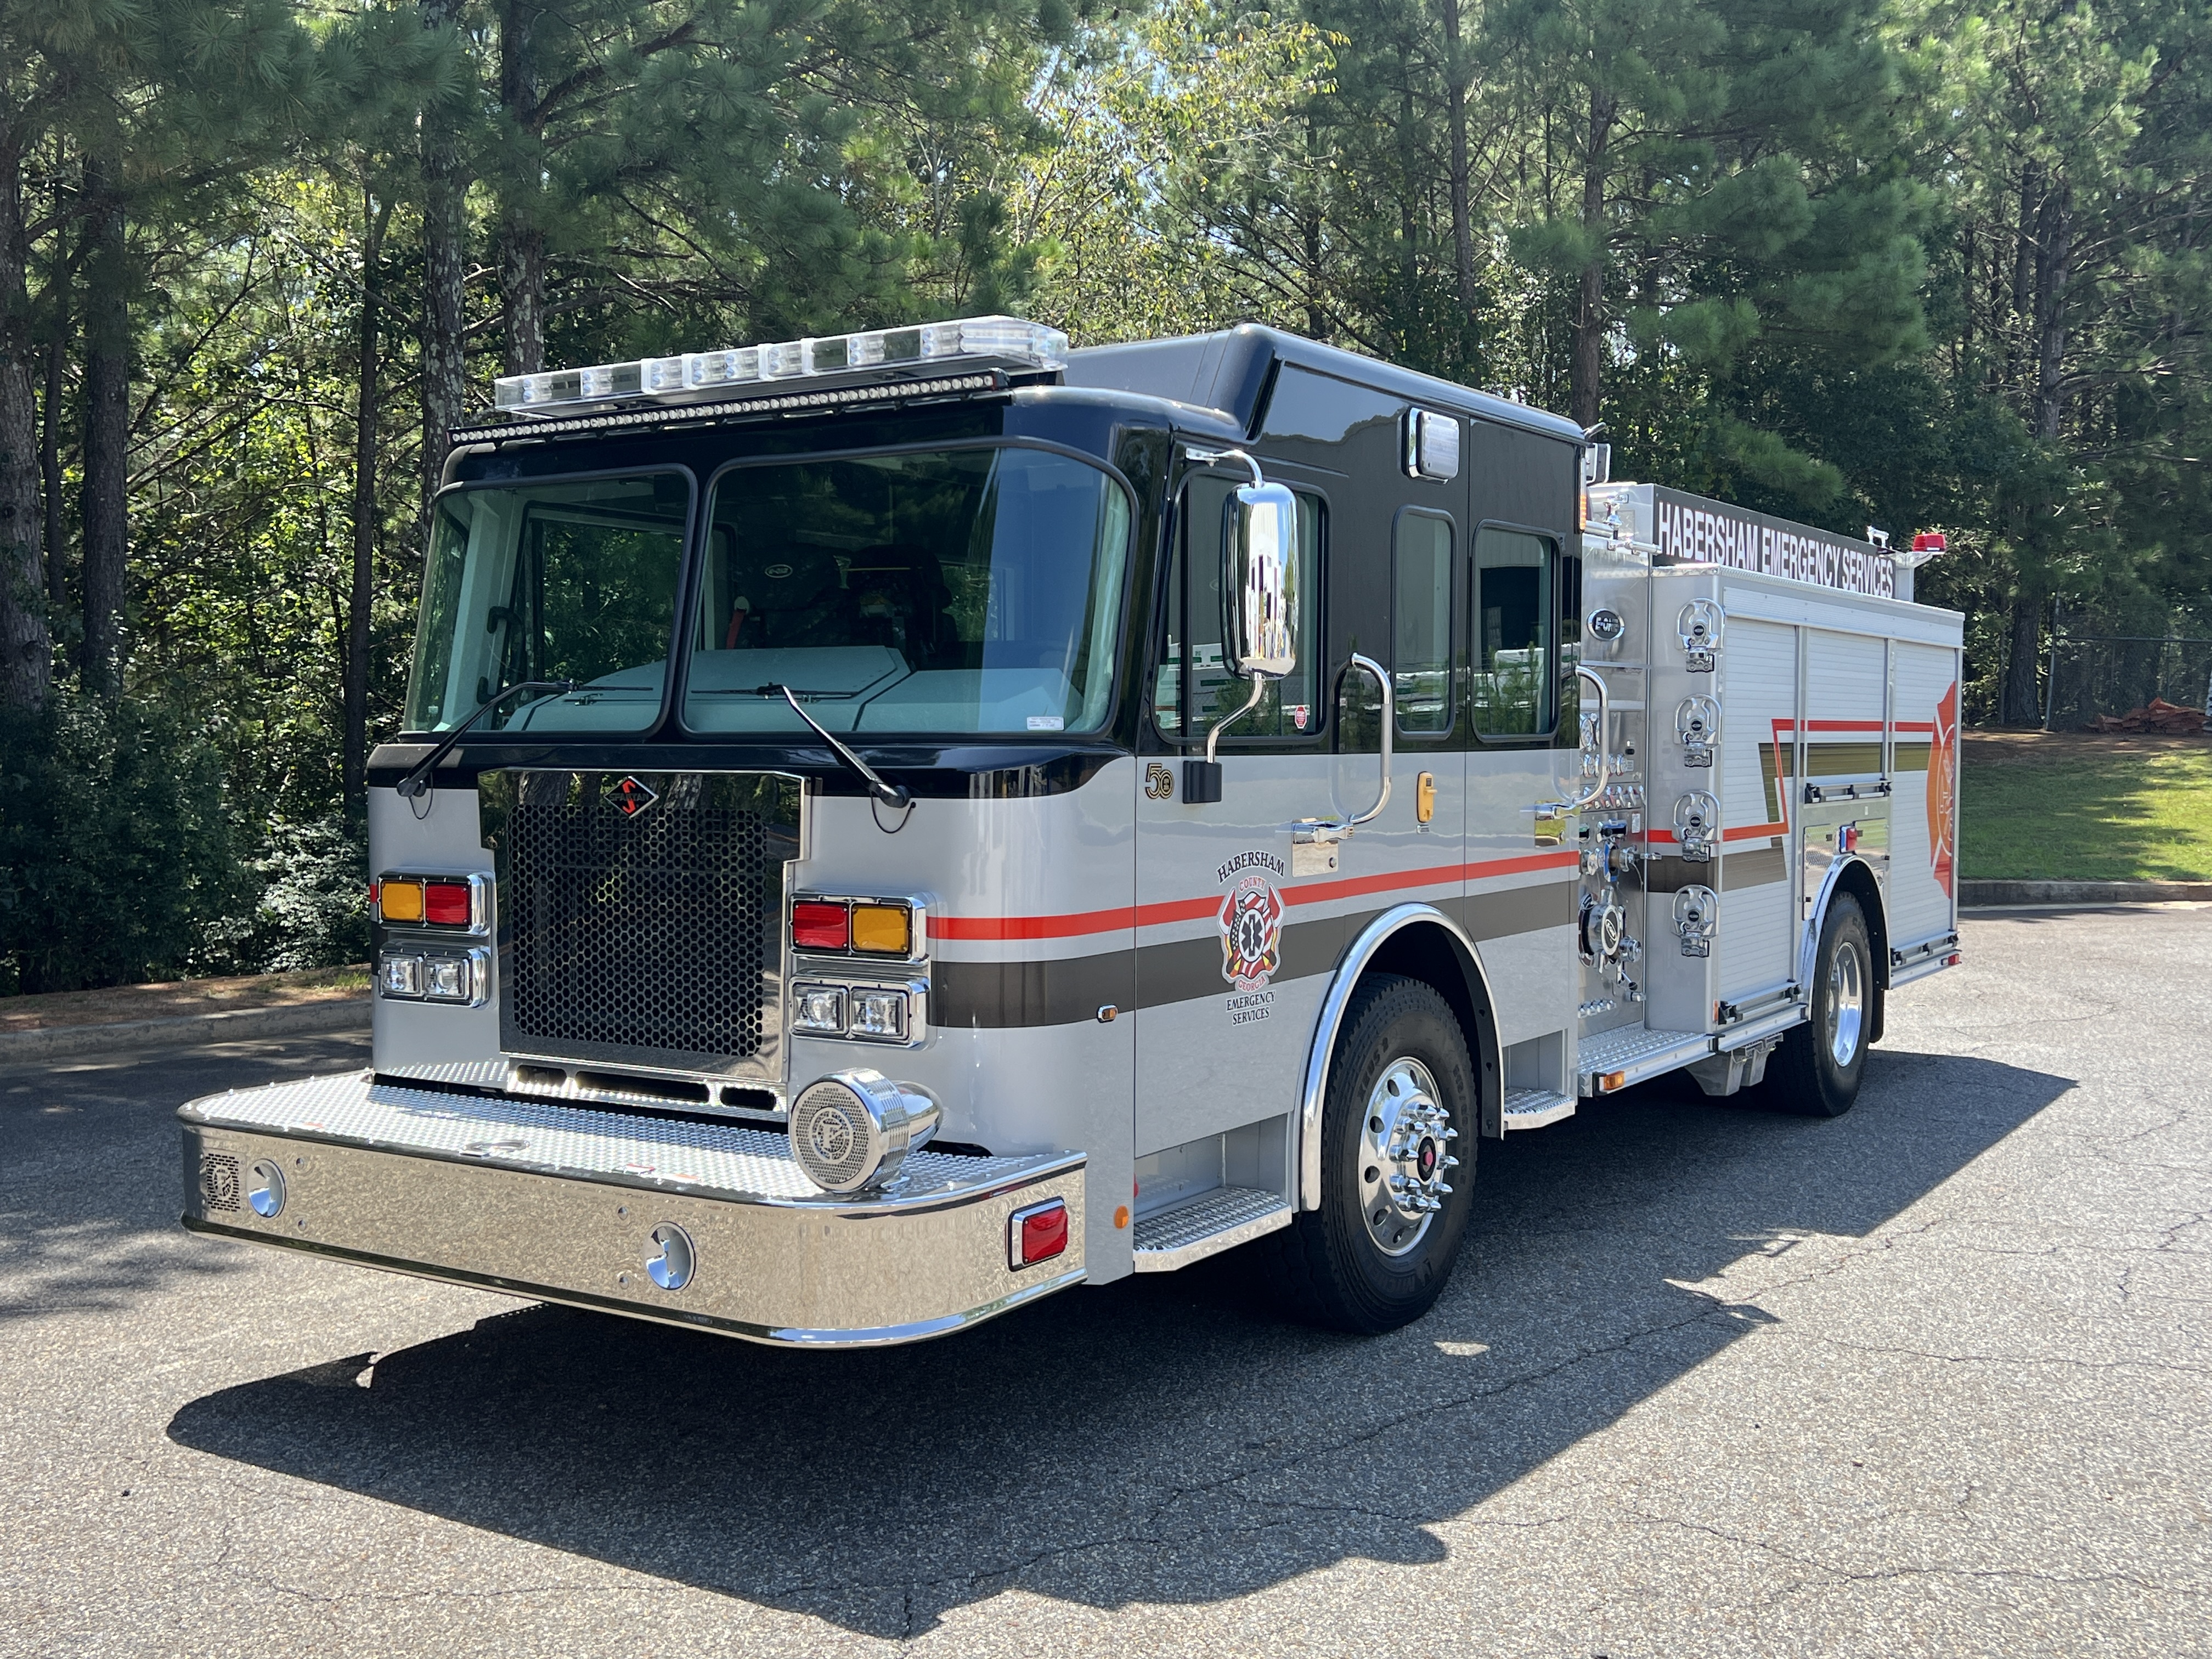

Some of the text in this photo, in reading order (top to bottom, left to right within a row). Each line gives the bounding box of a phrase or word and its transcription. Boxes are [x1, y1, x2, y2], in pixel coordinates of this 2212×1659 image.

[1658, 501, 1894, 598] HABERSHAM EMERGENCY SERVICES
[1145, 763, 1175, 799] 50
[609, 793, 649, 801] SPARTAN
[1217, 850, 1285, 883] HABERSHAM
[1239, 876, 1266, 891] COUNTY
[1238, 975, 1266, 992] GEORGIA
[1227, 991, 1276, 1011] EMERGENCY
[1233, 1007, 1269, 1025] SERVICES
